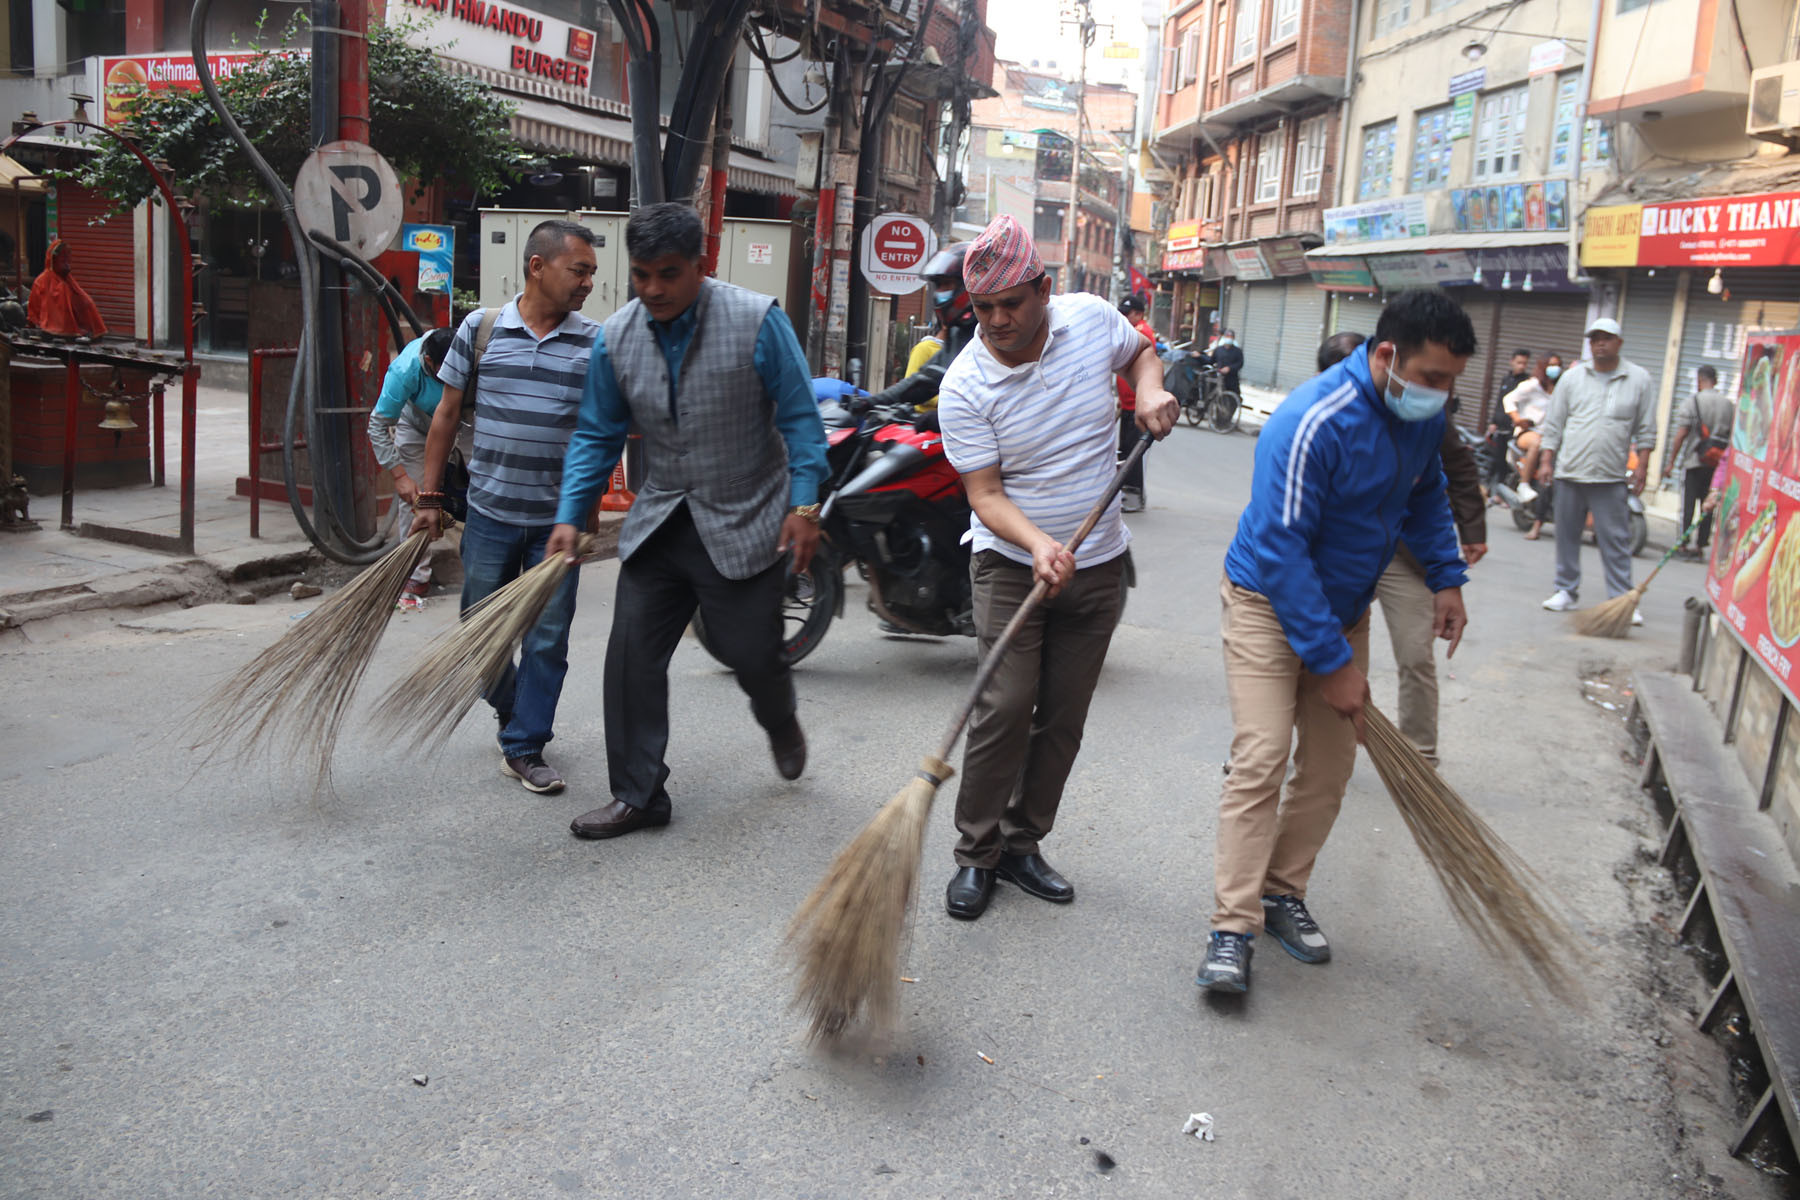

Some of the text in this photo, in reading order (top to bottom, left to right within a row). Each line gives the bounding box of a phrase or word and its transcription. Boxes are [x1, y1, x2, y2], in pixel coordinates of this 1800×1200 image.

[405, 0, 544, 43] HMANDU
[147, 58, 216, 82] Kathmanu
[219, 56, 262, 79] Burg
[512, 45, 589, 88] BURGER
[891, 225, 911, 237] NO
[1657, 204, 1722, 235] LUCKY
[881, 252, 919, 263] ENTRY
[875, 273, 918, 282] NO ENTRY
